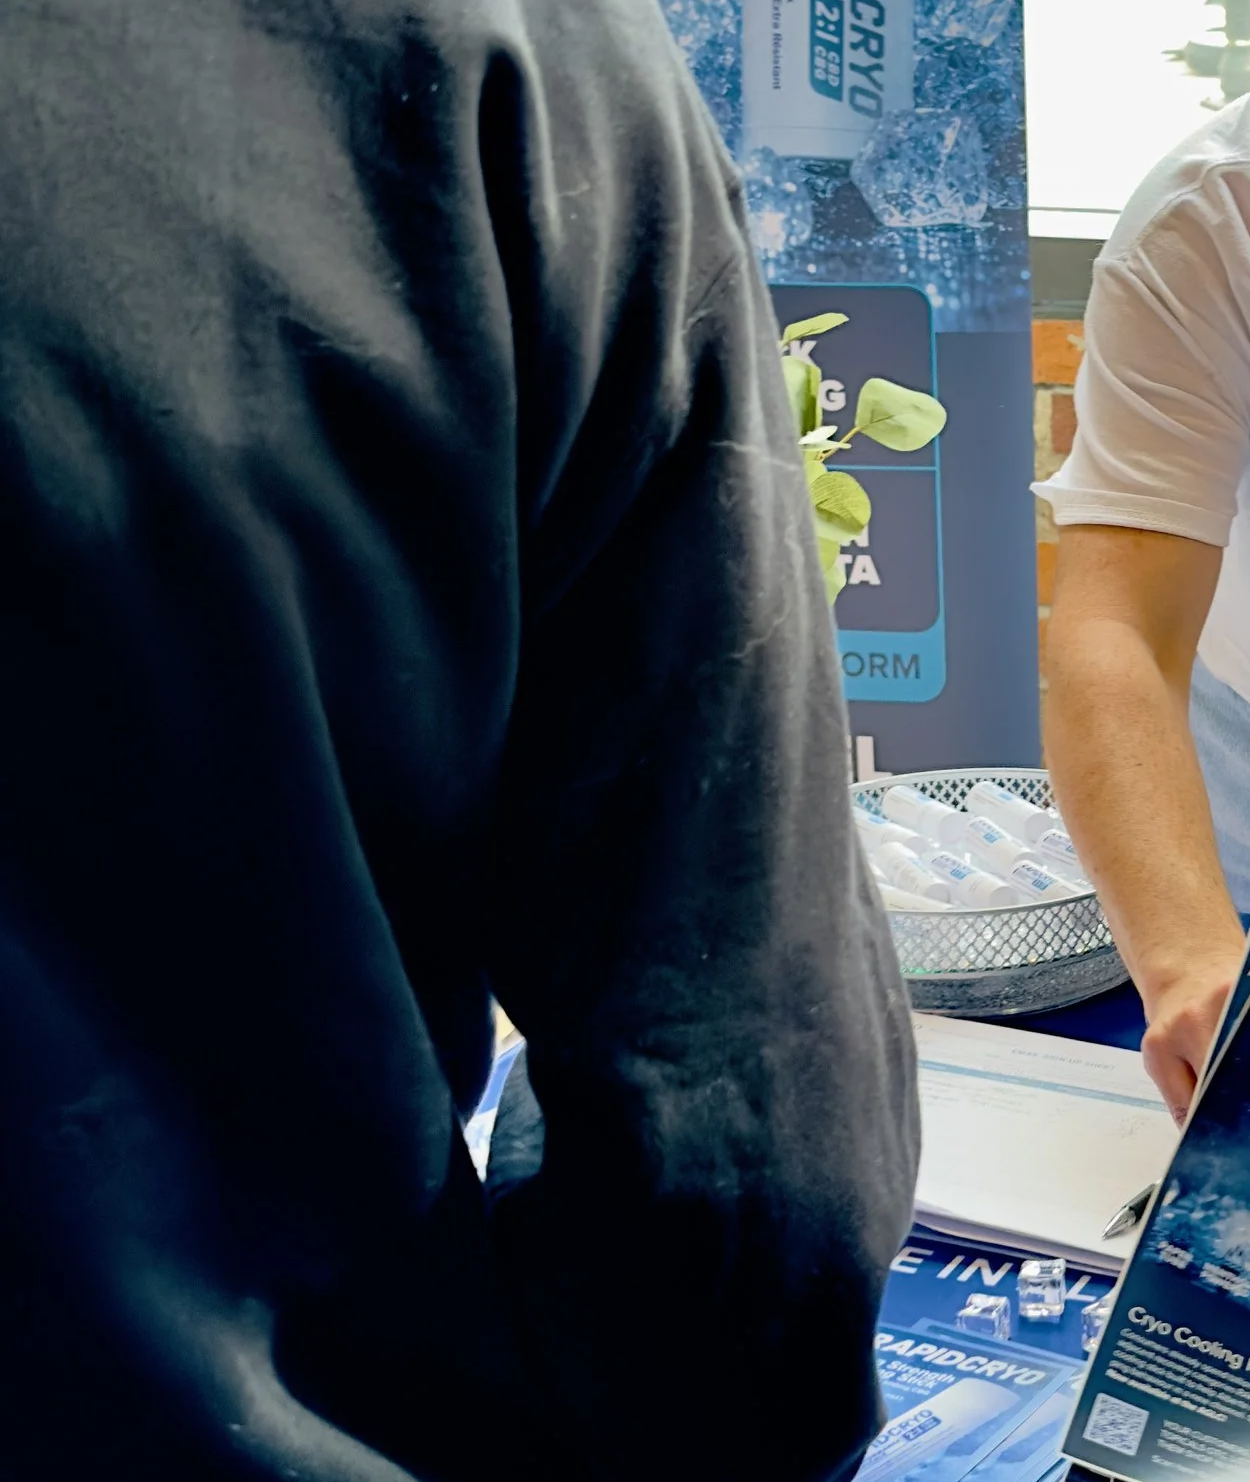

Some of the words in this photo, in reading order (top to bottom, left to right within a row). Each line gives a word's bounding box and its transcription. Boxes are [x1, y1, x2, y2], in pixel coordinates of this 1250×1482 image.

[936, 1254, 1015, 1288] IN
[1127, 1306, 1173, 1335] Cryo
[1173, 1327, 1244, 1370] Cooling
